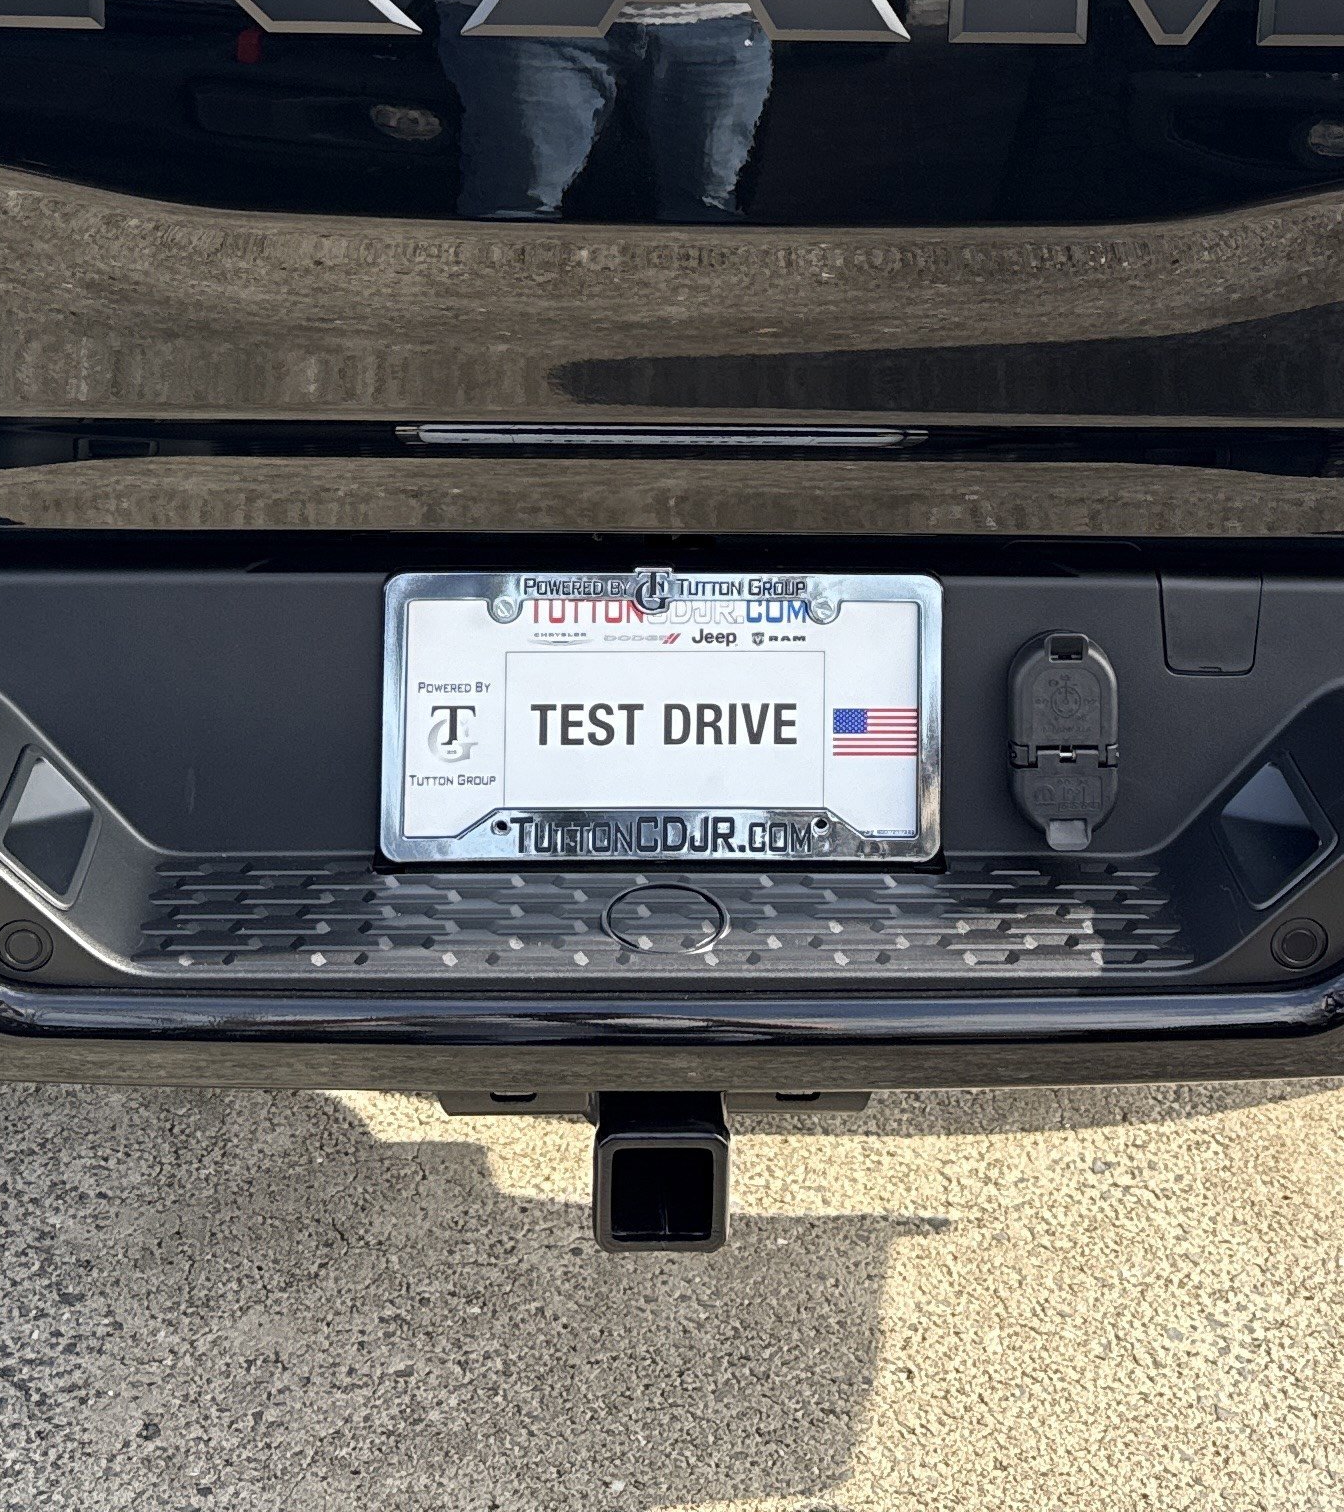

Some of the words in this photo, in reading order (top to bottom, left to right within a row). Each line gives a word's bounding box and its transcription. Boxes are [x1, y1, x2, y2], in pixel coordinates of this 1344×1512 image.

[691, 629, 737, 646] Jeep
[530, 703, 644, 746] TEST
[663, 703, 798, 745] DRIVE
